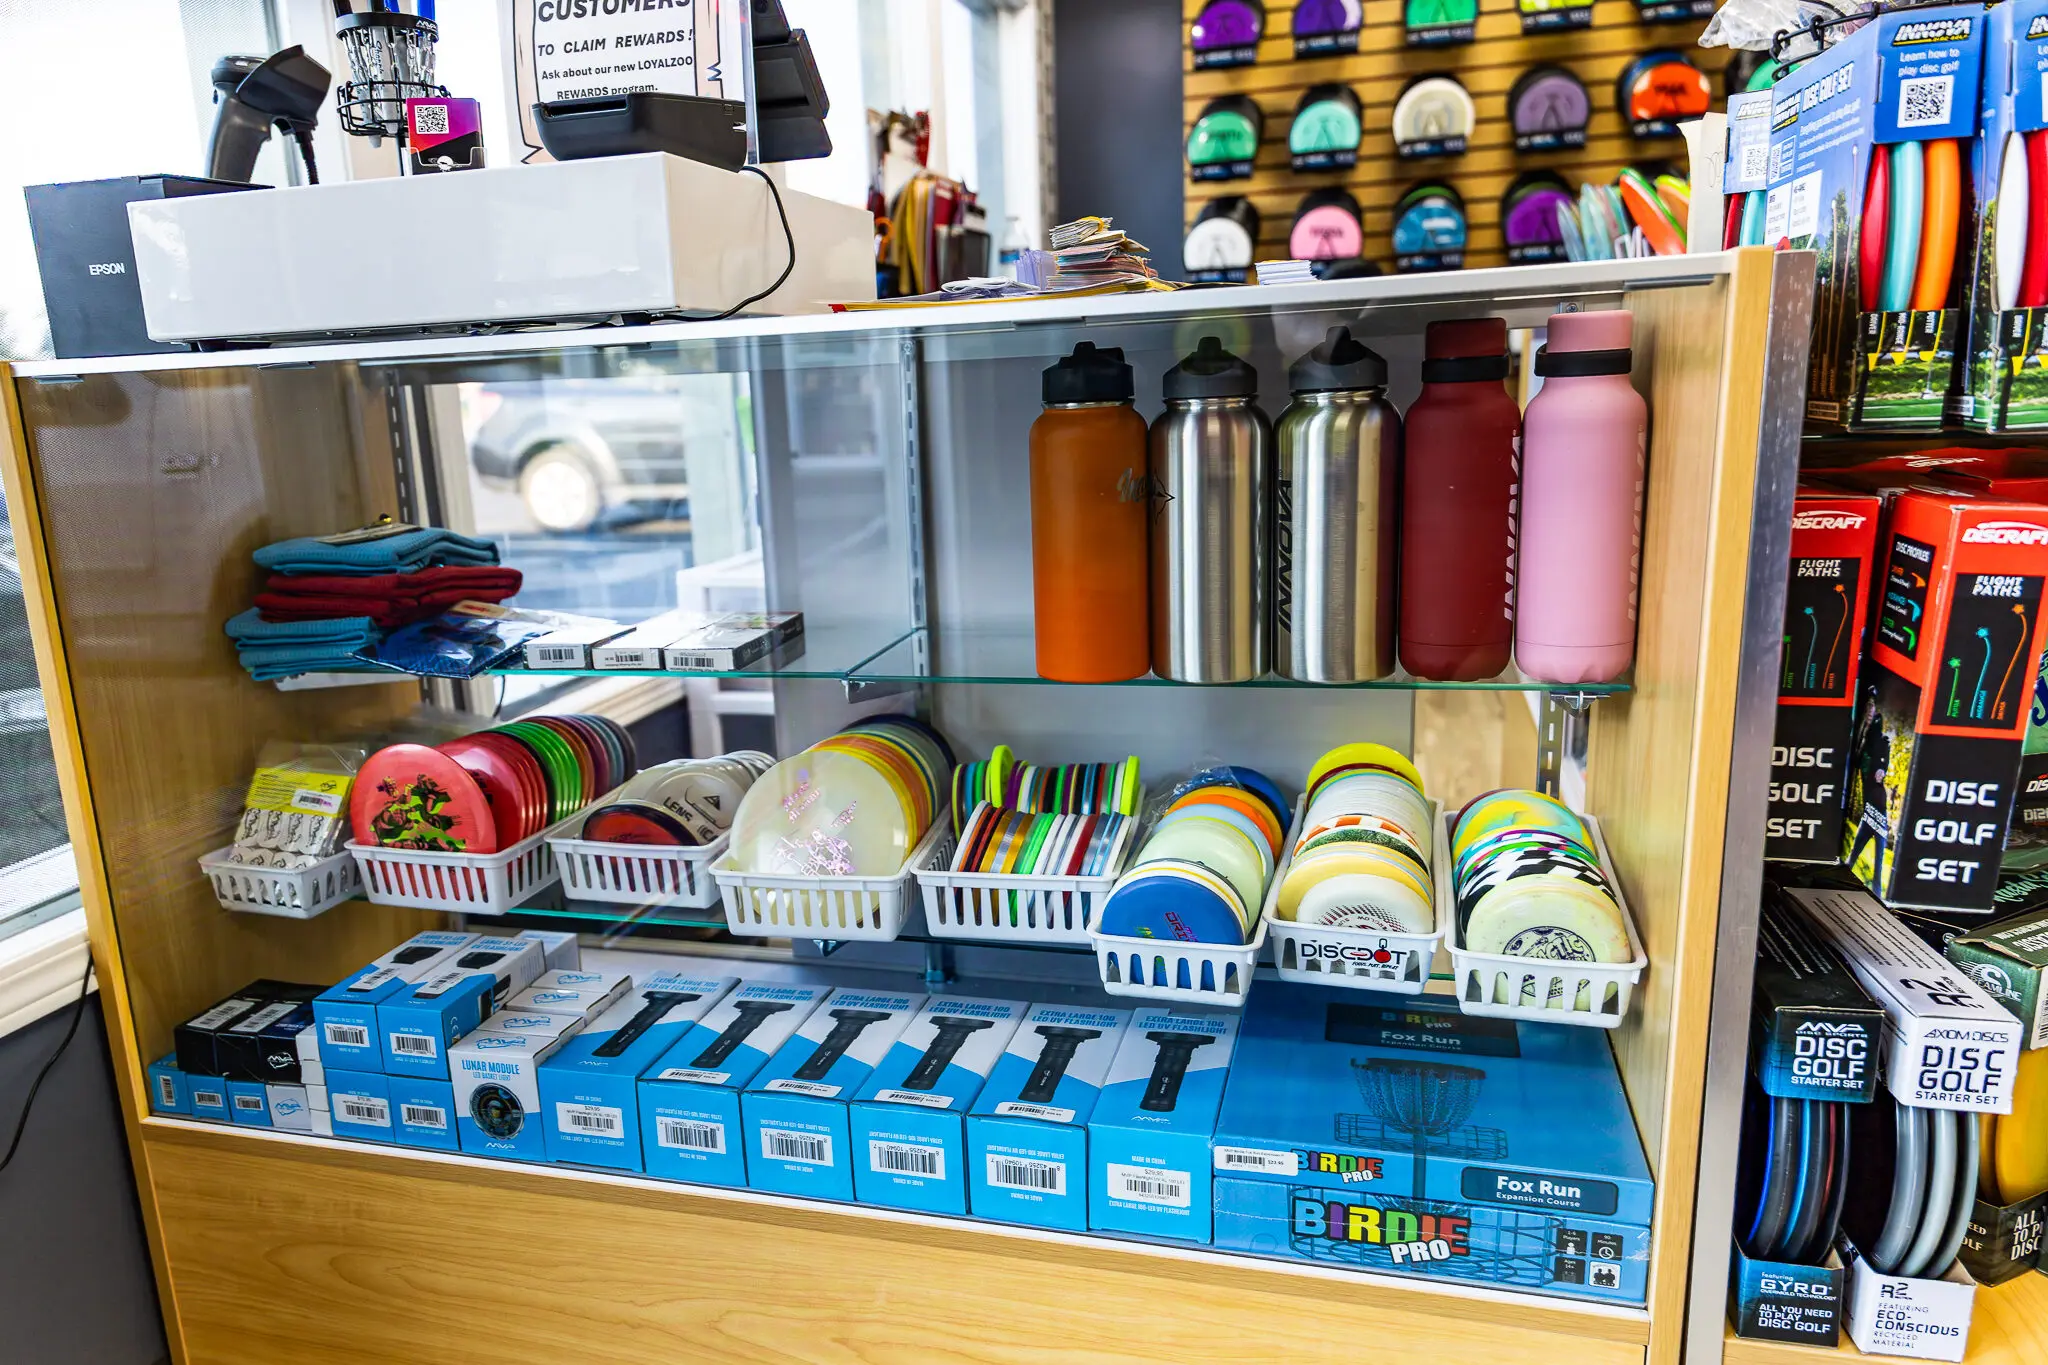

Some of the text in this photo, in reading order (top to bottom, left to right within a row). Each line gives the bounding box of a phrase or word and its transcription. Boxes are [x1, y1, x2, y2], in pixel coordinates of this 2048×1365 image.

[1894, 18, 1972, 41] INNOVA
[538, 44, 555, 56] TO
[563, 38, 606, 53] CLAIM
[1900, 48, 1960, 62] Learn how to
[541, 56, 693, 80] Ask about our new LOYALZOO
[1898, 61, 1960, 77] play disc golf
[557, 84, 658, 100] REWARDS program.
[89, 263, 125, 275] EPSON
[1792, 517, 1867, 530] DISCRAFT
[1278, 479, 1292, 634] INNOVA
[1800, 559, 1841, 568] FLIGHT
[1797, 567, 1841, 577] PATHS
[1975, 576, 2024, 587] FLIGHT
[1972, 584, 2023, 597] PATHS
[1771, 746, 1834, 768] DISC
[1767, 782, 1835, 804] GOLF
[1925, 780, 1999, 807] DISC
[663, 797, 693, 822] LENS
[1766, 817, 1822, 839] SET
[1914, 819, 1997, 846] GOLF
[1915, 858, 1980, 884] SET
[937, 1001, 964, 1009] EXTRA
[965, 1003, 992, 1011] LARGE
[959, 1008, 1012, 1019] FLASHLIGHT
[1039, 1010, 1066, 1018] EXTRA
[1068, 1012, 1096, 1020] LARGE
[1063, 1017, 1118, 1028] FLASHLIGHT
[1145, 1016, 1225, 1028] EXTRA LARGE 100
[1381, 1012, 1457, 1027] BRDE
[1170, 1024, 1227, 1034] FLASHLIGHT
[1797, 1021, 1865, 1033] MVP
[1381, 1031, 1462, 1045] Fox Run
[1923, 1028, 2009, 1043] AXIOM DISCS
[1795, 1036, 1868, 1060] DISC
[1921, 1045, 2006, 1072] DISC
[461, 1059, 521, 1075] LUNAR MODULE
[1792, 1057, 1865, 1080] GOLF
[1790, 1075, 1865, 1090] STARTER SET
[1918, 1069, 2002, 1094] GOLF
[1915, 1090, 1999, 1105] STARTER SET
[485, 1142, 516, 1150] MVP
[1131, 1155, 1145, 1163] MADE
[1151, 1157, 1166, 1165] CHINA
[1296, 1150, 1384, 1179] BIRDIE
[1341, 1169, 1374, 1184] PRO
[1496, 1175, 1581, 1199] Fox Run
[1496, 1192, 1581, 1208] Expansion Course
[1292, 1197, 1472, 1257] BIRDIE
[1968, 1222, 1987, 1235] EED
[2014, 1210, 2038, 1232] ALL
[1597, 1239, 1617, 1247] Minutes
[1962, 1236, 1984, 1251] OLF
[2013, 1228, 2029, 1245] TO
[1389, 1239, 1452, 1265] PRO
[1761, 1272, 1794, 1281] featuring
[1760, 1278, 1828, 1295] GYRO
[1760, 1288, 1837, 1301] OVERMOLD TECHNOLOGY
[1759, 1303, 1833, 1318] ALL YOU NEED
[1879, 1302, 1929, 1313] FEATURING
[1759, 1310, 1801, 1321] TO PLAY
[1877, 1310, 1912, 1321] ECO-
[1758, 1317, 1831, 1334] DISC GOLF
[1875, 1320, 1960, 1337] CONSCIOUS
[1874, 1331, 1918, 1341] RECYCLED
[1872, 1339, 1915, 1349] MATERIAL
